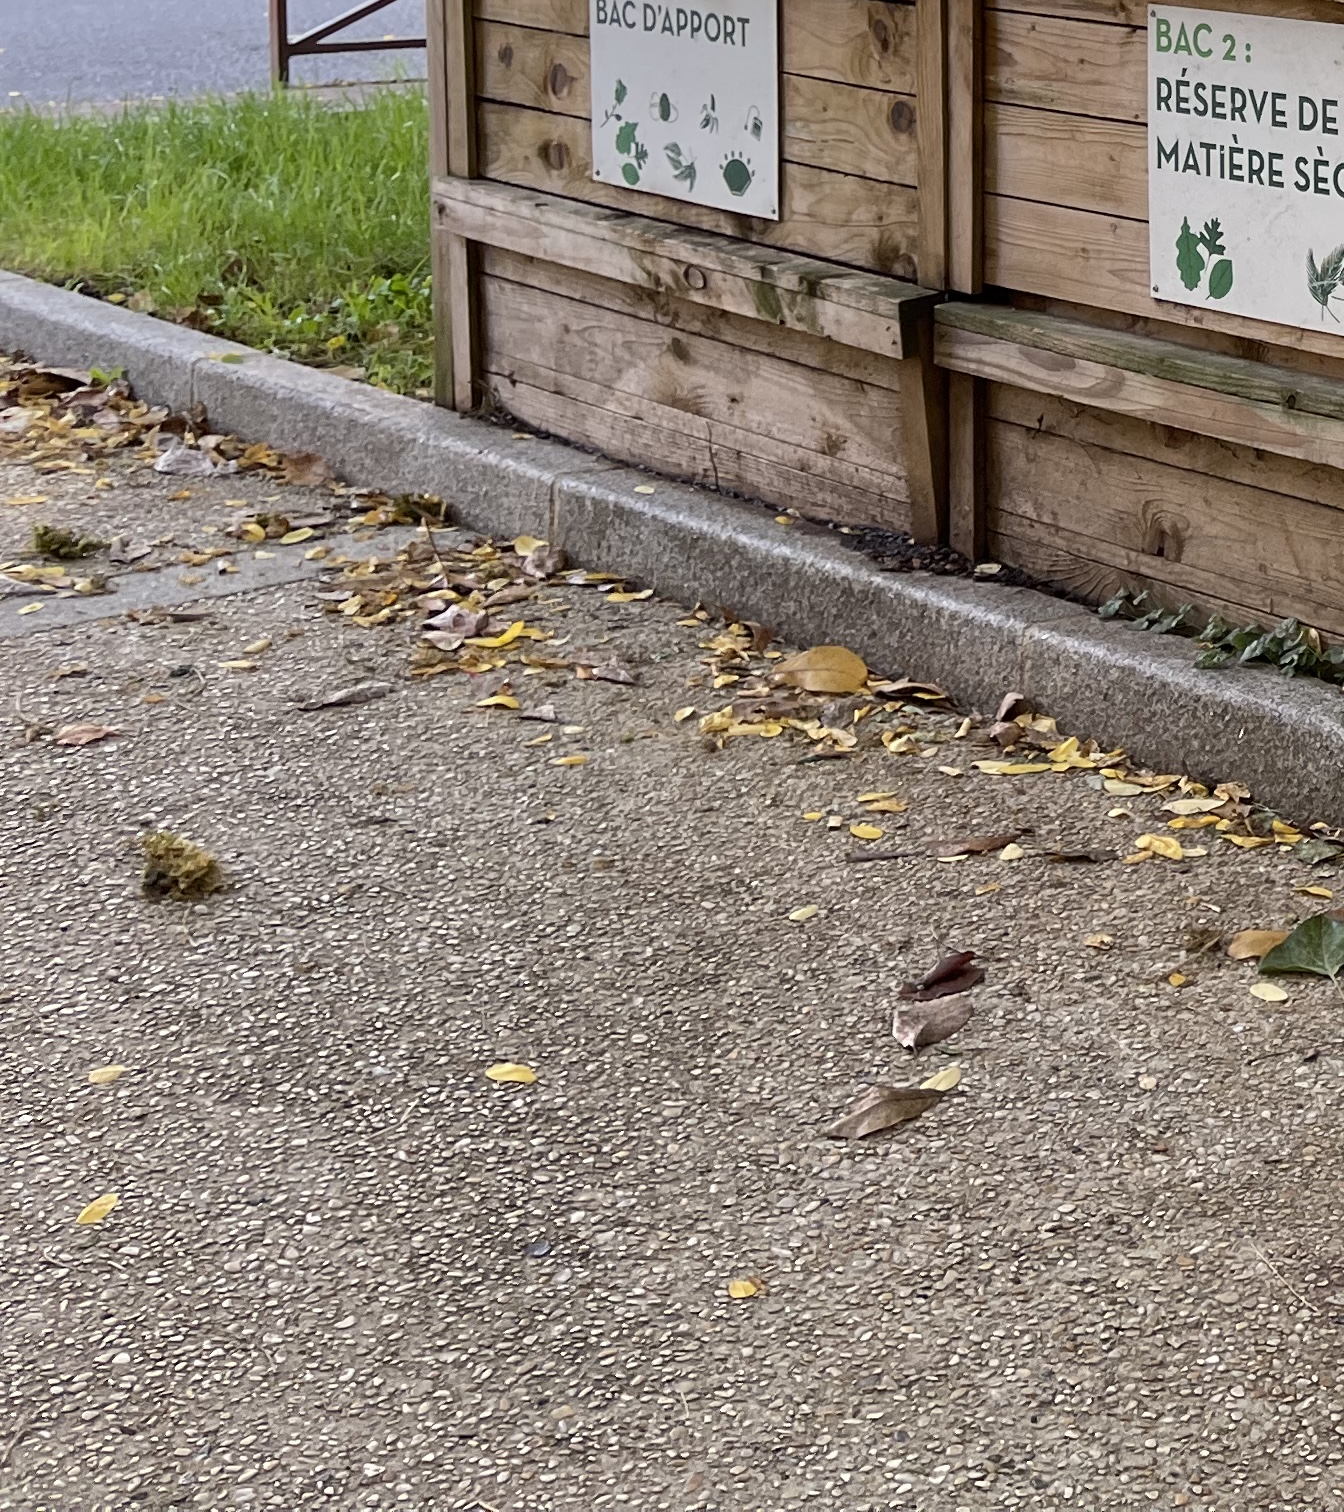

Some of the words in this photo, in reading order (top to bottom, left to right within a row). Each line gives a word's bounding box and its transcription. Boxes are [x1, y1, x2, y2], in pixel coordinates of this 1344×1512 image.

[1155, 17, 1214, 58] BAC
[1221, 32, 1237, 62] 2
[1156, 65, 1288, 129] RÉSERVE
[1297, 94, 1339, 136] DE
